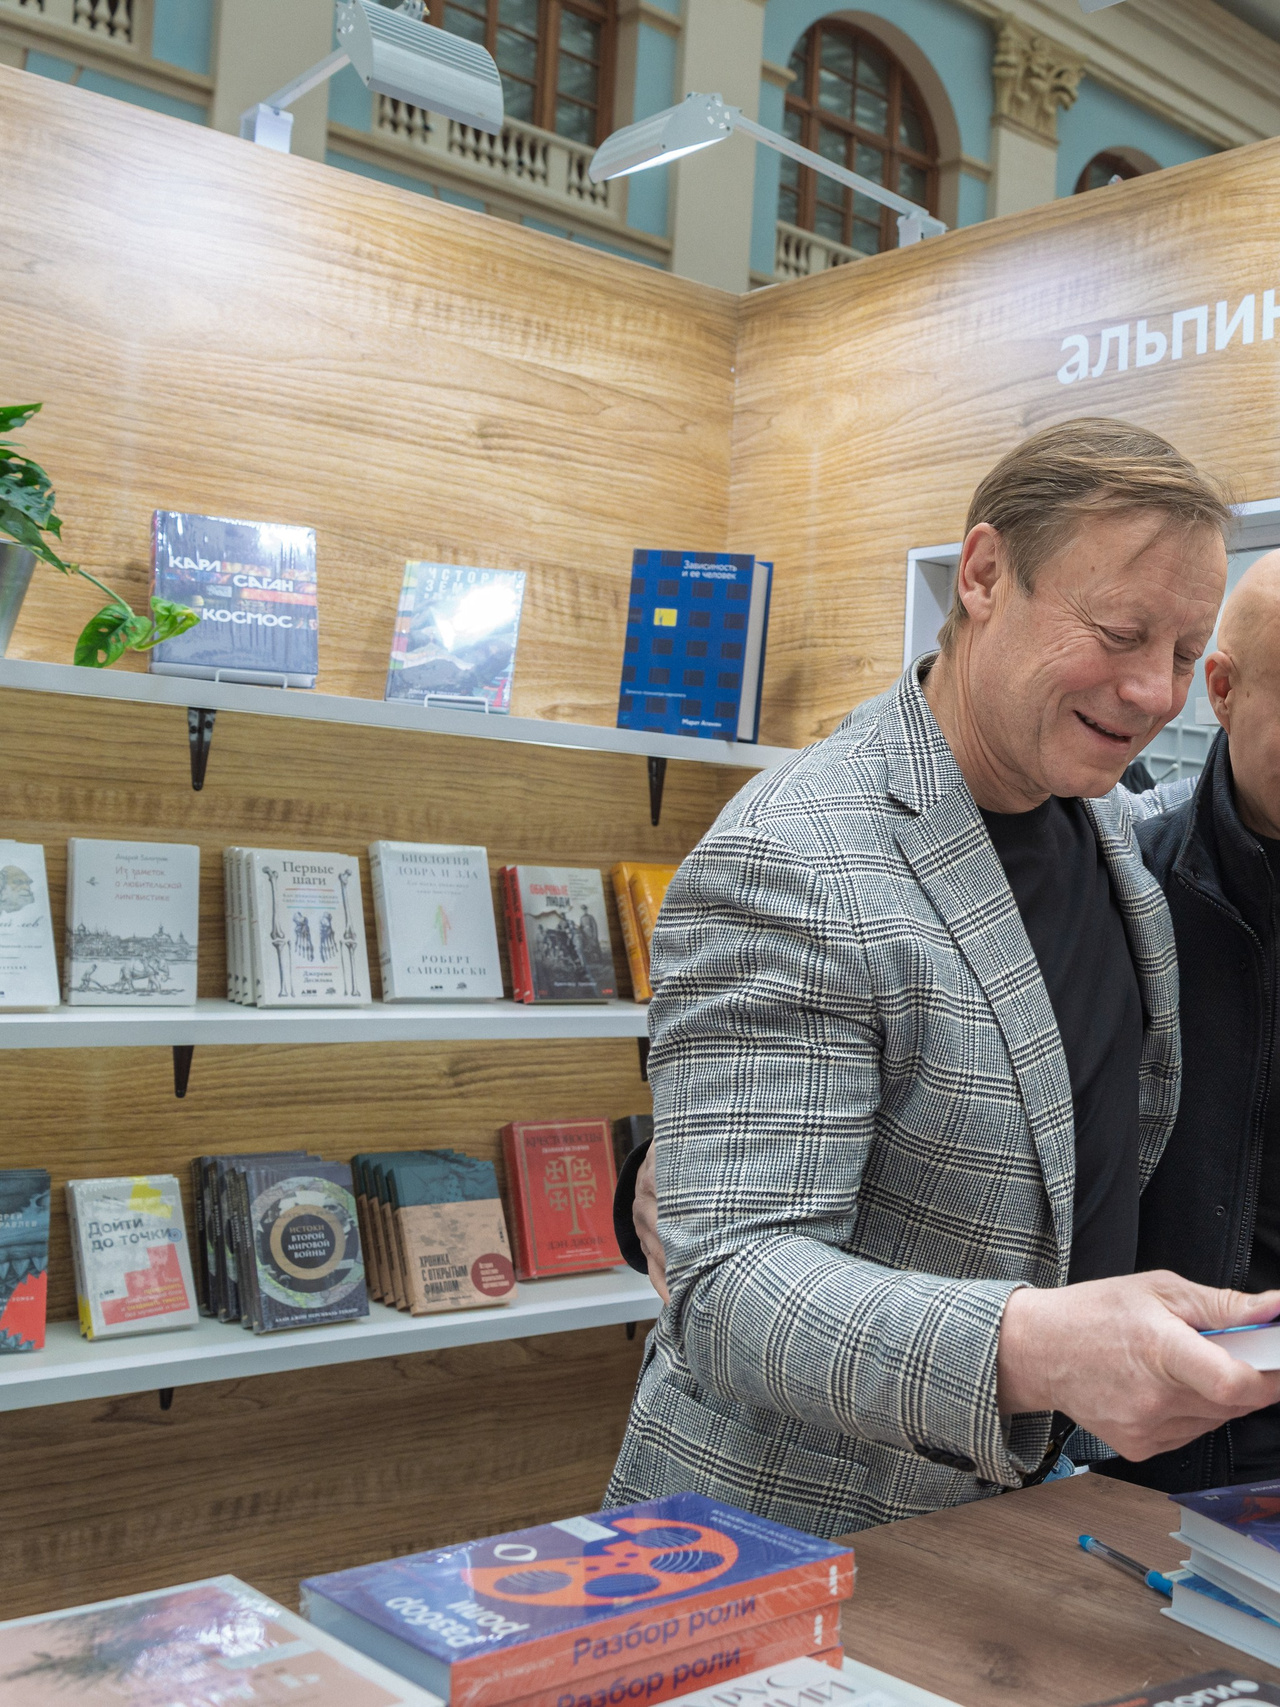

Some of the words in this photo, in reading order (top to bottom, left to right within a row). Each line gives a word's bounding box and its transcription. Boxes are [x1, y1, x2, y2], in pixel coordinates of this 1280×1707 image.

[169, 555, 221, 572] КАРЛ
[683, 560, 738, 572] Зависимость
[233, 574, 294, 592] САГАН
[202, 608, 293, 628] КОСМОС
[401, 853, 470, 866] БИОЛОГИЯ
[282, 861, 334, 877] Первые
[292, 876, 326, 886] шаги
[421, 955, 470, 964] РОБЕРТ
[406, 966, 487, 976] САПОЛЬСКИ
[88, 1217, 144, 1239] Дойти
[289, 1224, 325, 1234] ИСТОКИ
[91, 1238, 114, 1253] до
[119, 1228, 172, 1246] точки
[291, 1231, 325, 1242] ВТОРОЙ
[287, 1240, 330, 1251] МИРОВОЙ
[294, 1248, 326, 1259] ВОЙНЫ
[419, 1253, 450, 1268] ХРОНИКА
[427, 1264, 469, 1281] ОТКРЫТЫМ
[424, 1279, 460, 1294] ФИНАЛОМ
[384, 1595, 475, 1649] Разбор
[446, 1598, 531, 1639] роли
[571, 1616, 681, 1666] Разбор
[688, 1594, 756, 1637] роли
[556, 1670, 665, 1707] Разбор
[672, 1647, 741, 1691] роли
